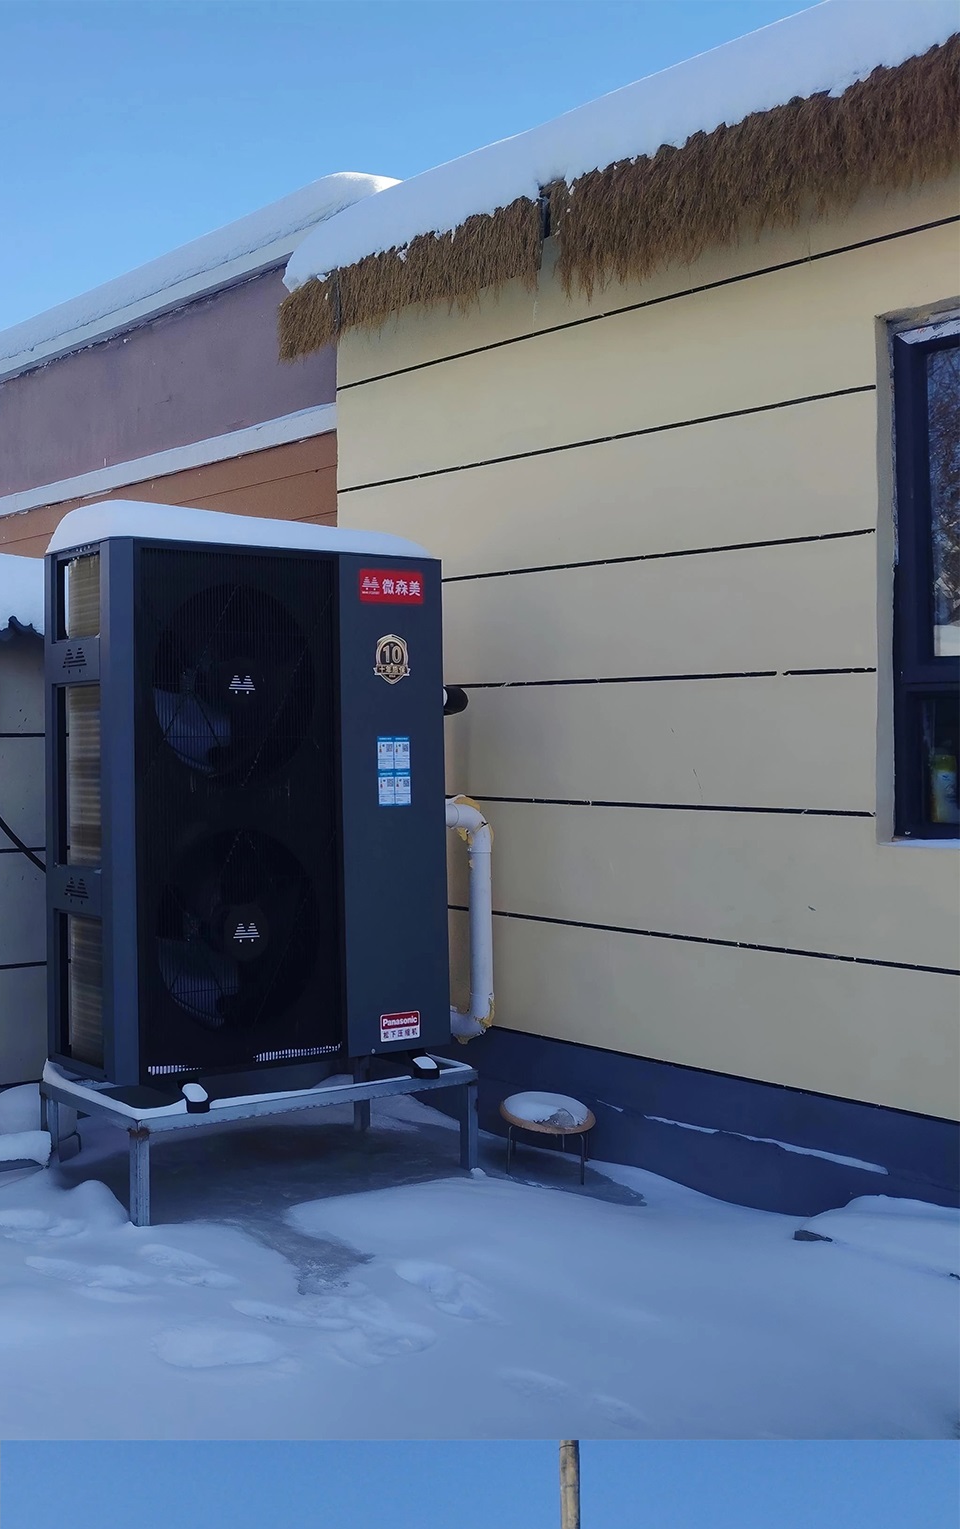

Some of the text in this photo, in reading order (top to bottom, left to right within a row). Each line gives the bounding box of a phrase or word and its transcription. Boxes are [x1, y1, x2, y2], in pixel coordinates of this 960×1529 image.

[382, 579, 421, 597] 微森美
[382, 645, 402, 664] 10
[382, 1015, 418, 1027] Panasonic
[383, 1028, 418, 1039] 松下压缩机
